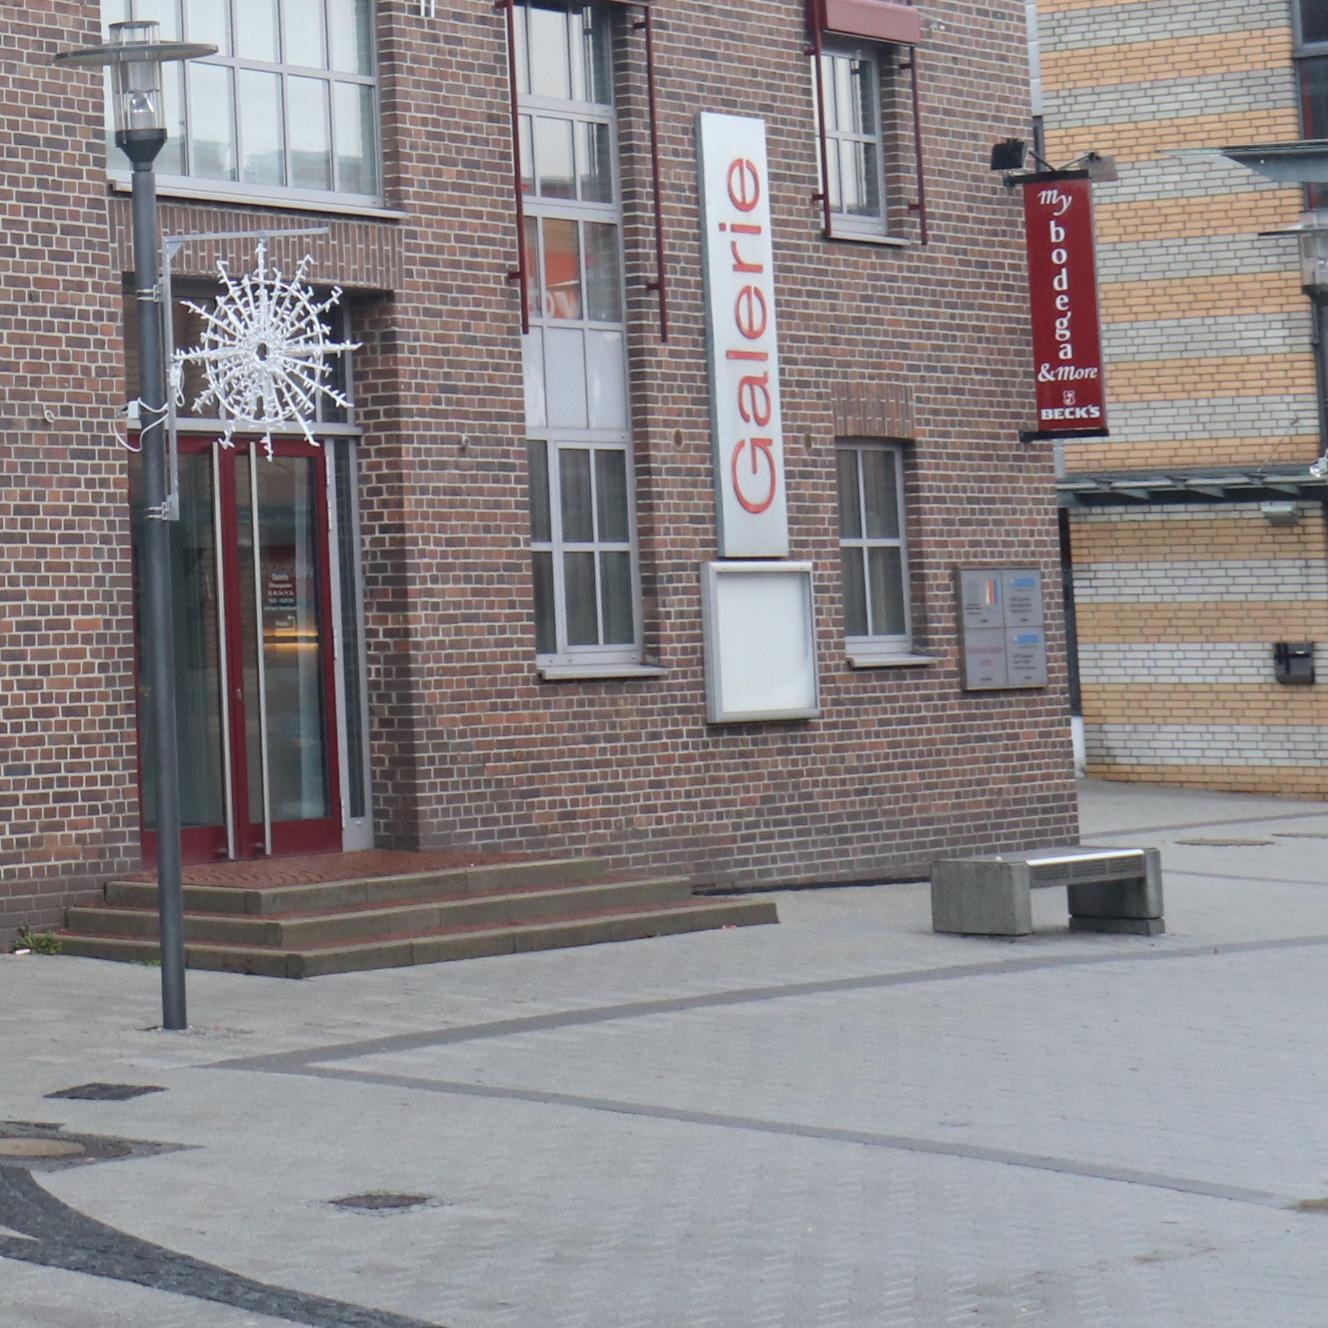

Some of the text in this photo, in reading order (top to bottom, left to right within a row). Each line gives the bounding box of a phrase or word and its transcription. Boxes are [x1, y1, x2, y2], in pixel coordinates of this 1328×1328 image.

[1036, 189, 1073, 216] my
[718, 157, 777, 515] Galerie
[1049, 220, 1073, 360] bodega
